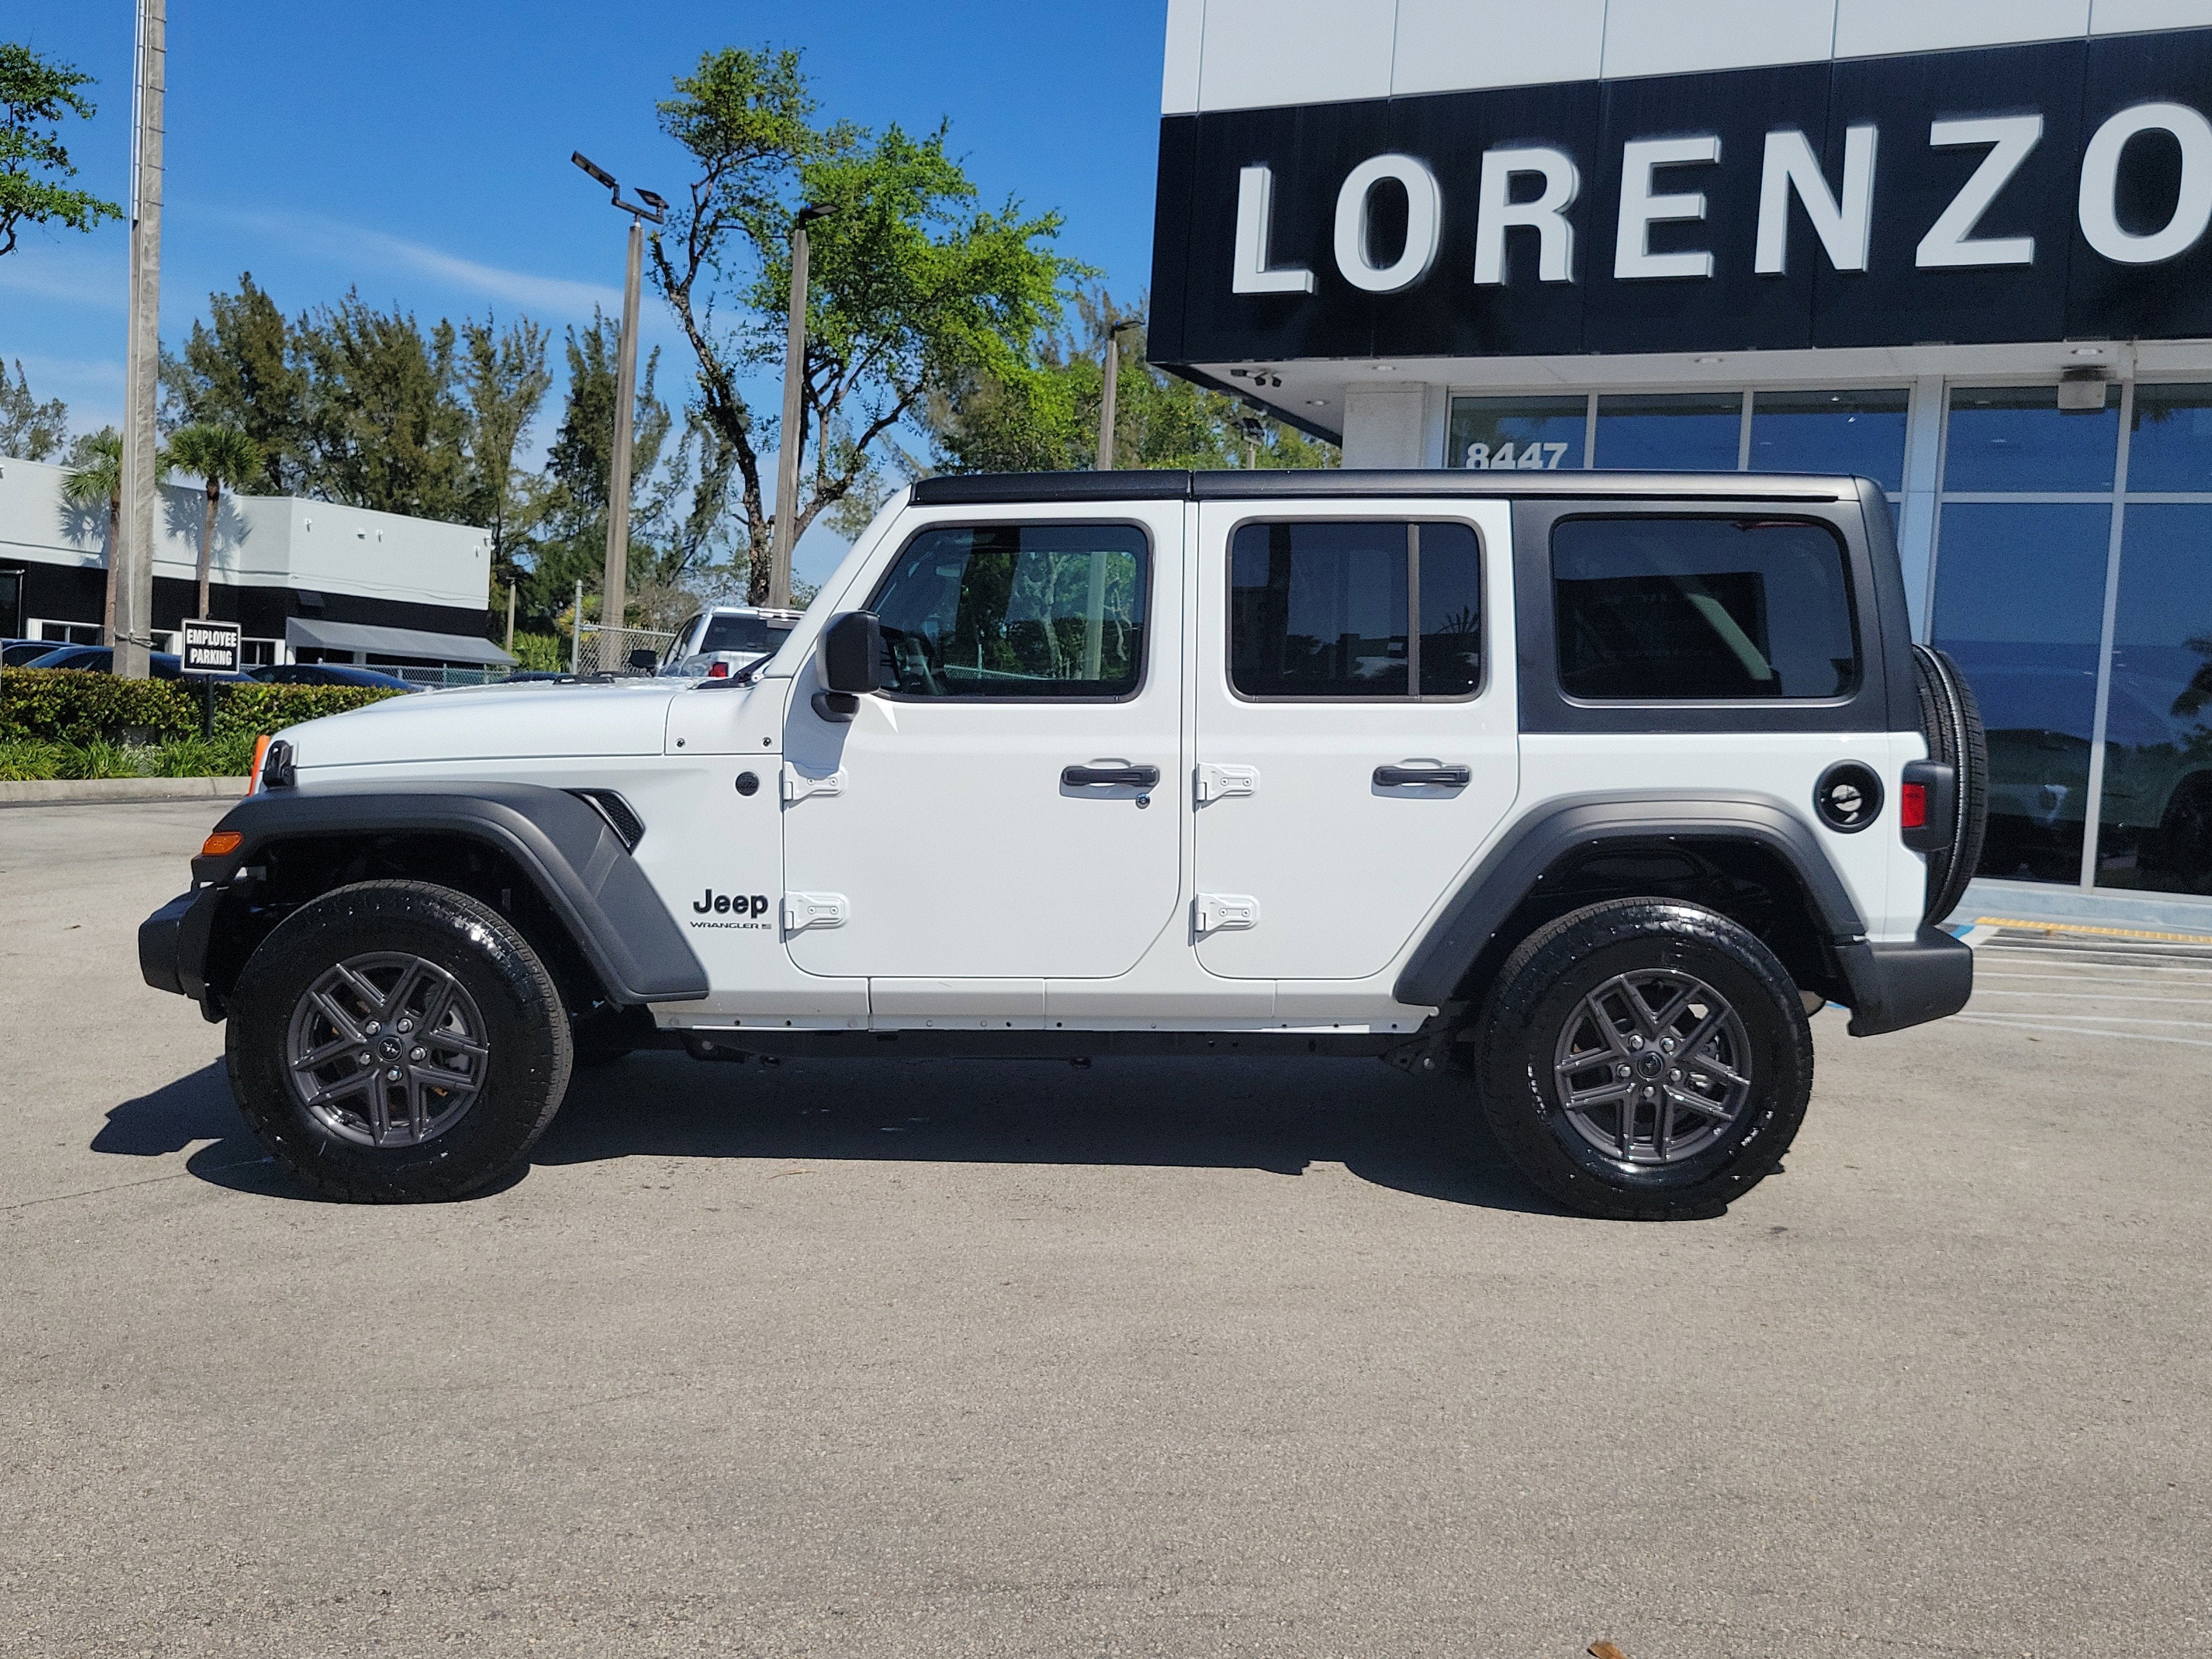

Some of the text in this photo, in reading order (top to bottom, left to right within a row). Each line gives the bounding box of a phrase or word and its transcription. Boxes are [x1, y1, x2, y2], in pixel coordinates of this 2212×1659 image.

[1233, 102, 2212, 294] LORENZO
[1466, 442, 1568, 469] 8447
[186, 628, 237, 647] EMPLOYEE
[190, 648, 232, 666] PARKING
[693, 889, 768, 919] Jeep
